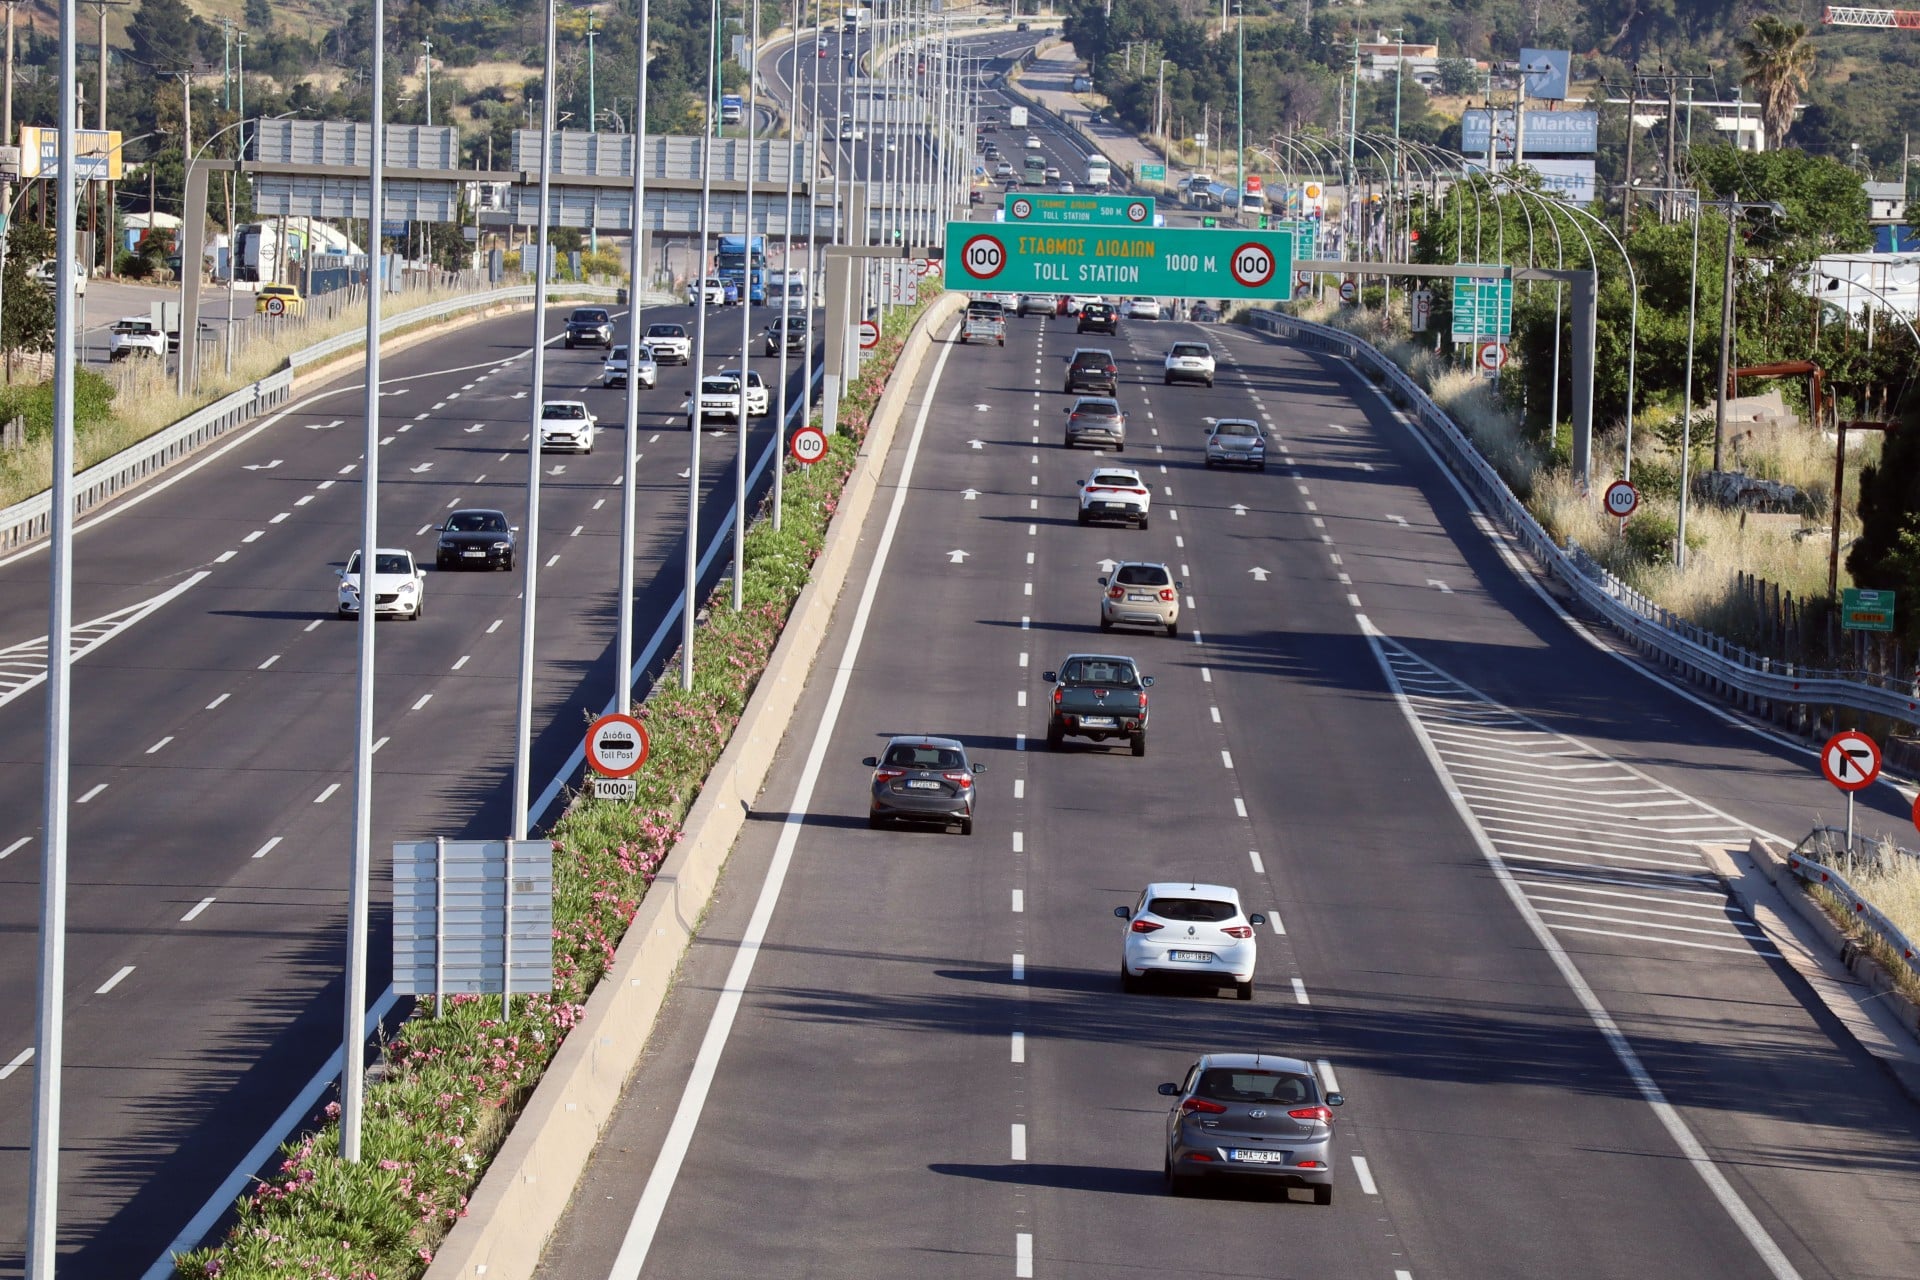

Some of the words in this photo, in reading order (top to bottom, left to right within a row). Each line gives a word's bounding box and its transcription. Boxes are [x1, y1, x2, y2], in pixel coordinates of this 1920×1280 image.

[1532, 116, 1593, 131] Market
[1016, 205, 1028, 213] 60
[1043, 211, 1059, 220] TOLL
[1063, 212, 1090, 221] STATION
[1100, 207, 1114, 216] 500
[1131, 208, 1144, 217] 60
[1018, 237, 1086, 256] ΣΤΑΘΜΟΣ
[1095, 239, 1155, 258] ΔΙΟΔΙΩΝ
[970, 248, 1000, 266] 100
[1165, 254, 1199, 272] 1000
[1238, 256, 1268, 274] 100
[1033, 262, 1069, 281] TOLL
[1079, 264, 1139, 283] STATION
[269, 302, 281, 310] 60
[798, 438, 821, 452] 100
[1611, 492, 1633, 505] 100
[601, 751, 614, 760] Toll
[616, 751, 633, 760] Post
[596, 782, 627, 796] 1000
